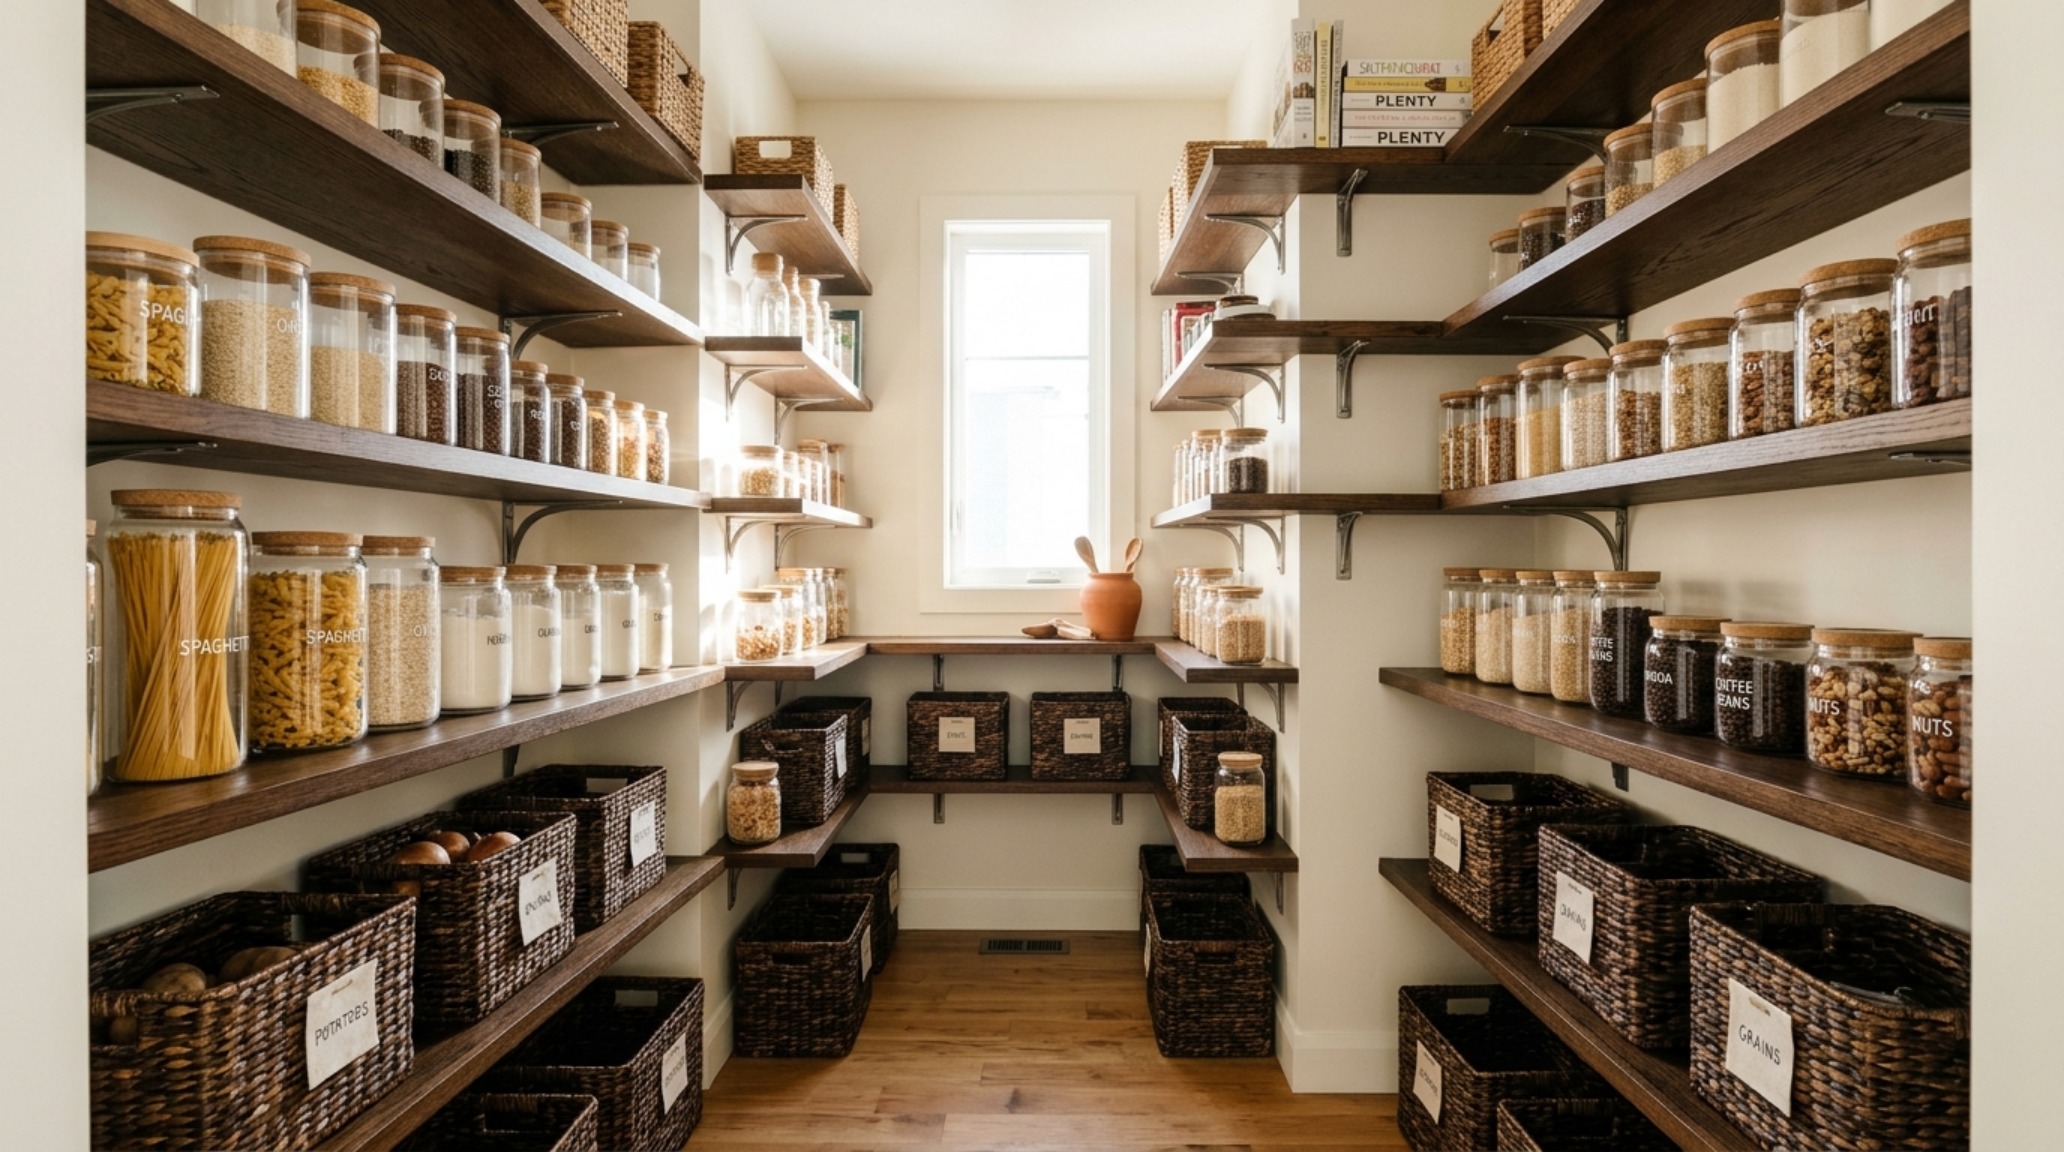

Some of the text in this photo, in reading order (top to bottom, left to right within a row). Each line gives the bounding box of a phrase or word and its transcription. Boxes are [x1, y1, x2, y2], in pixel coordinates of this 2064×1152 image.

[1375, 94, 1437, 107] PLENTY
[1377, 131, 1446, 145] PLENTY
[1911, 715, 1954, 738] NUTS
[1738, 1023, 1782, 1066] GRAINS
